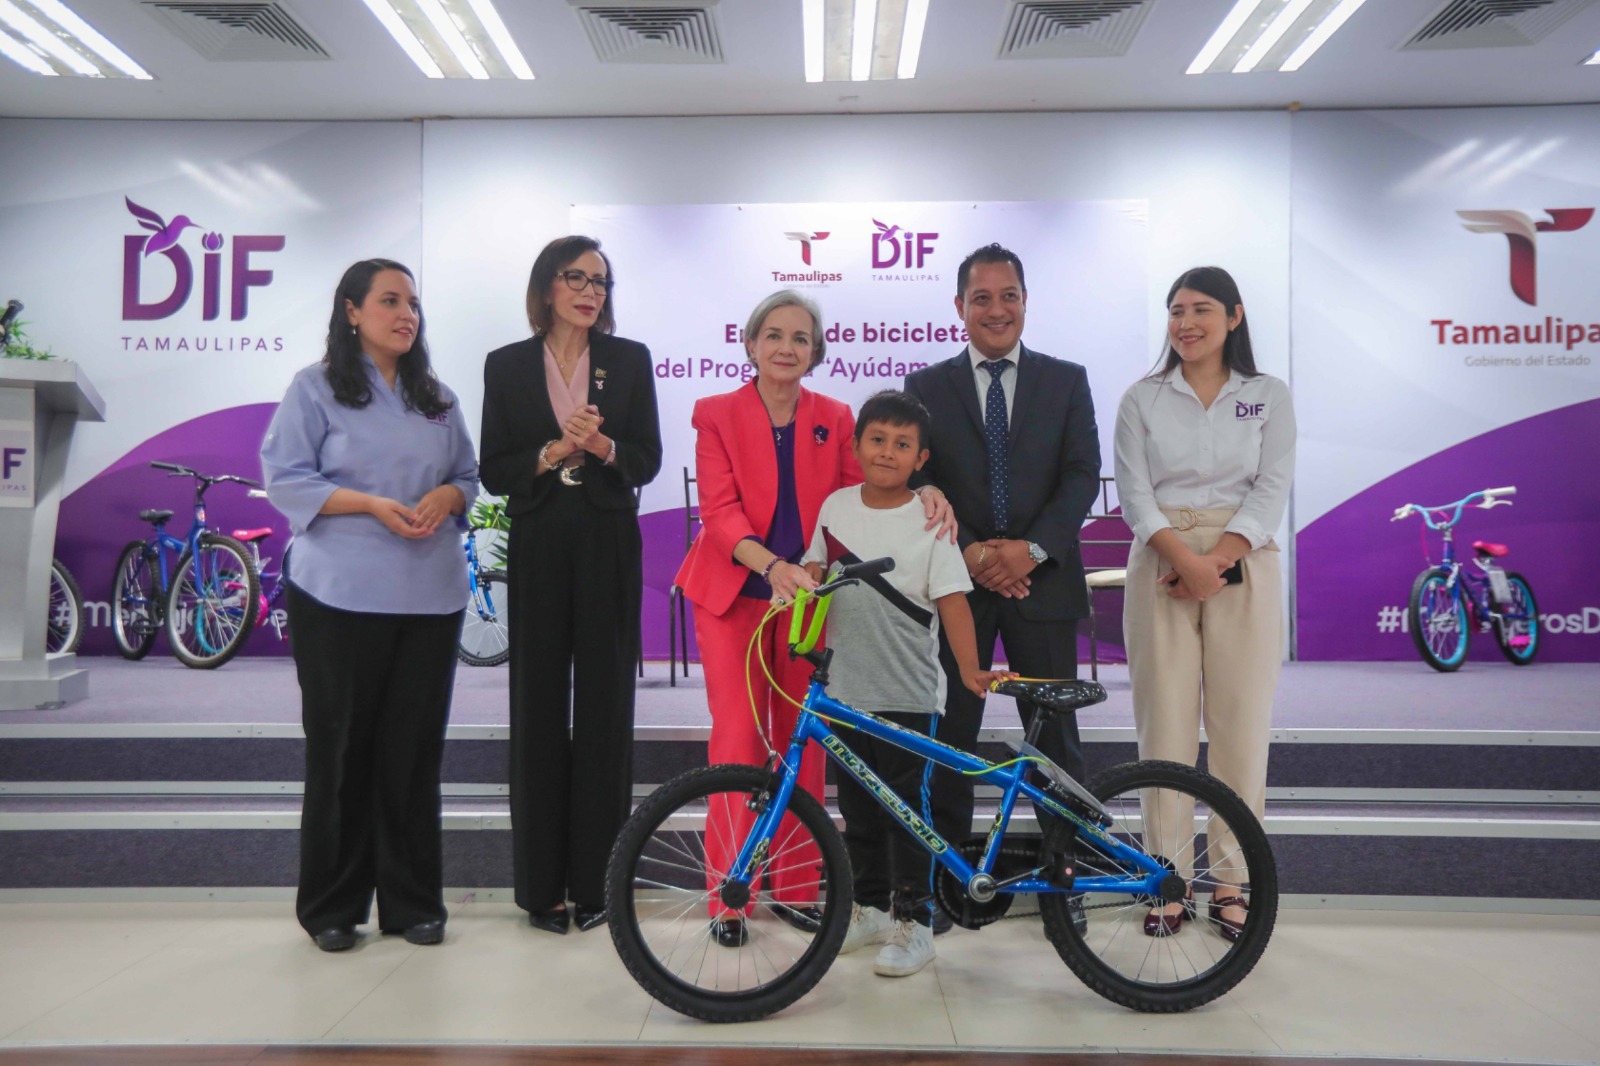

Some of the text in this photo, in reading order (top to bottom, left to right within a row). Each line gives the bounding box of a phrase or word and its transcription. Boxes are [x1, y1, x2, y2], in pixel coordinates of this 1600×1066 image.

[772, 271, 842, 284] Tamaulipas
[872, 274, 940, 282] TAMAULIPAS
[825, 322, 856, 343] de
[121, 337, 284, 352] TAMAULIPAS
[655, 357, 692, 378] del
[1464, 354, 1591, 367] Gobierno del Estado
